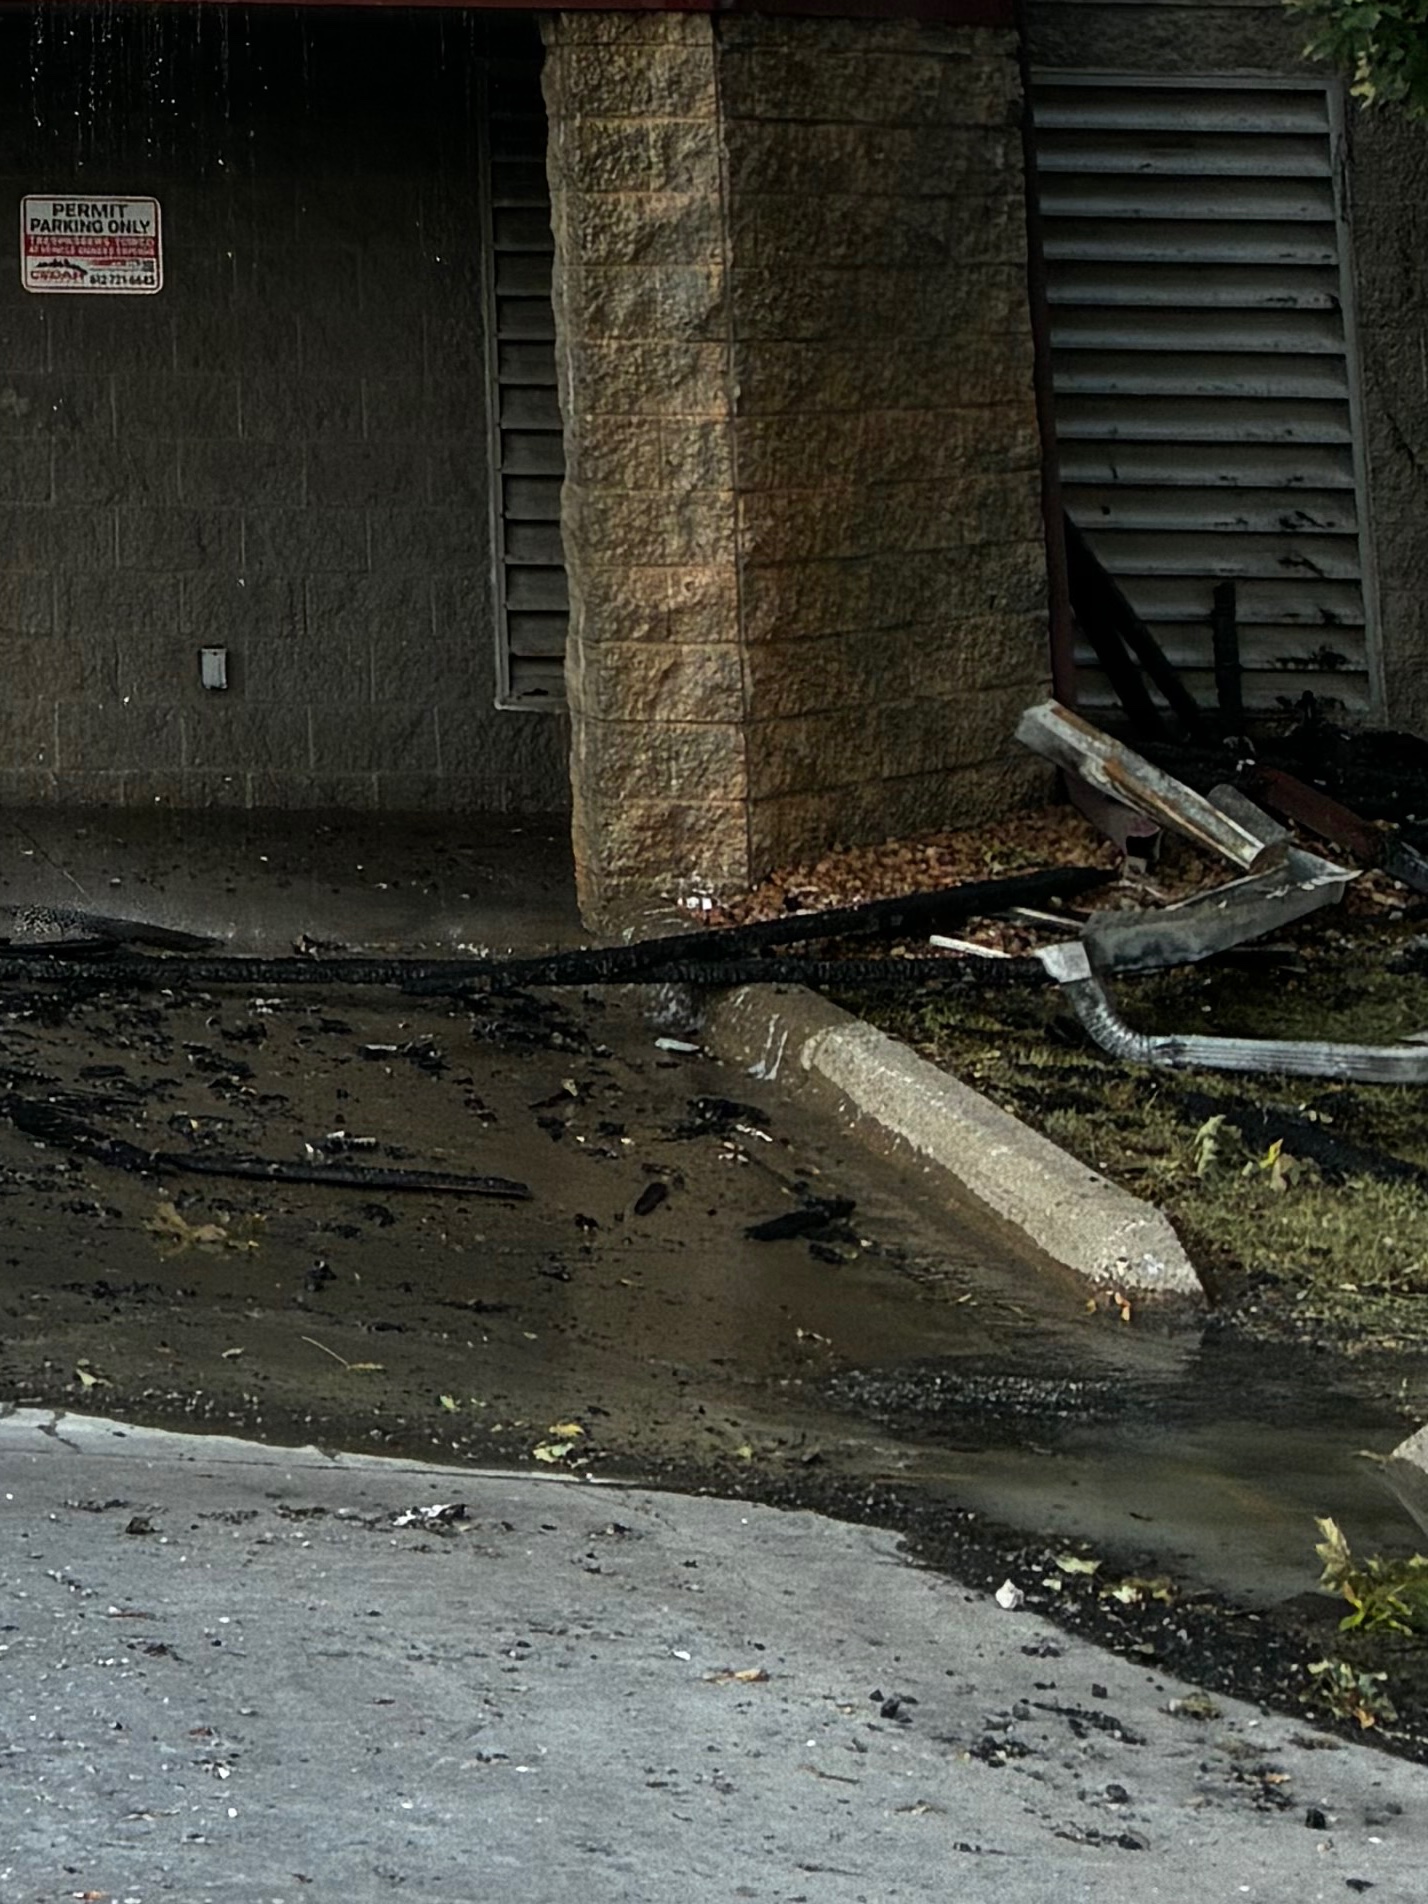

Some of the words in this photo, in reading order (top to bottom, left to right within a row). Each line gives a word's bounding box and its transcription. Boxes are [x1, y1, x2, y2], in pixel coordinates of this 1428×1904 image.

[52, 203, 128, 218] PERMIT
[30, 218, 104, 234] PARKING
[107, 219, 150, 234] ONLY
